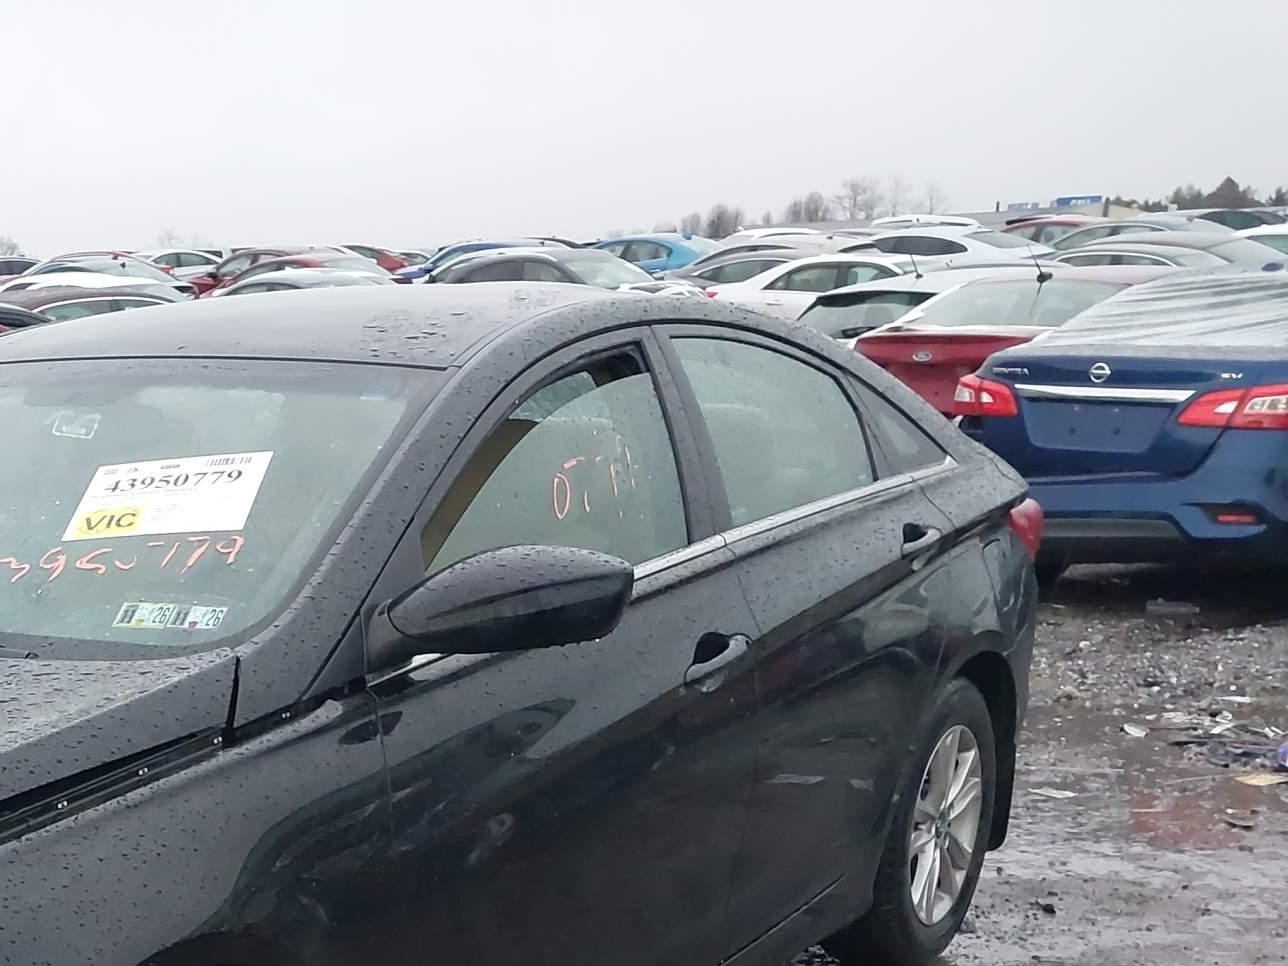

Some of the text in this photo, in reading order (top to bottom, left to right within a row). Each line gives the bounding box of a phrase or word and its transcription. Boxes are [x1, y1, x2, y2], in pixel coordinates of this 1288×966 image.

[104, 469, 243, 493] 43950779
[85, 512, 137, 531] VIC
[152, 606, 171, 624] 26
[205, 609, 224, 627] 26
